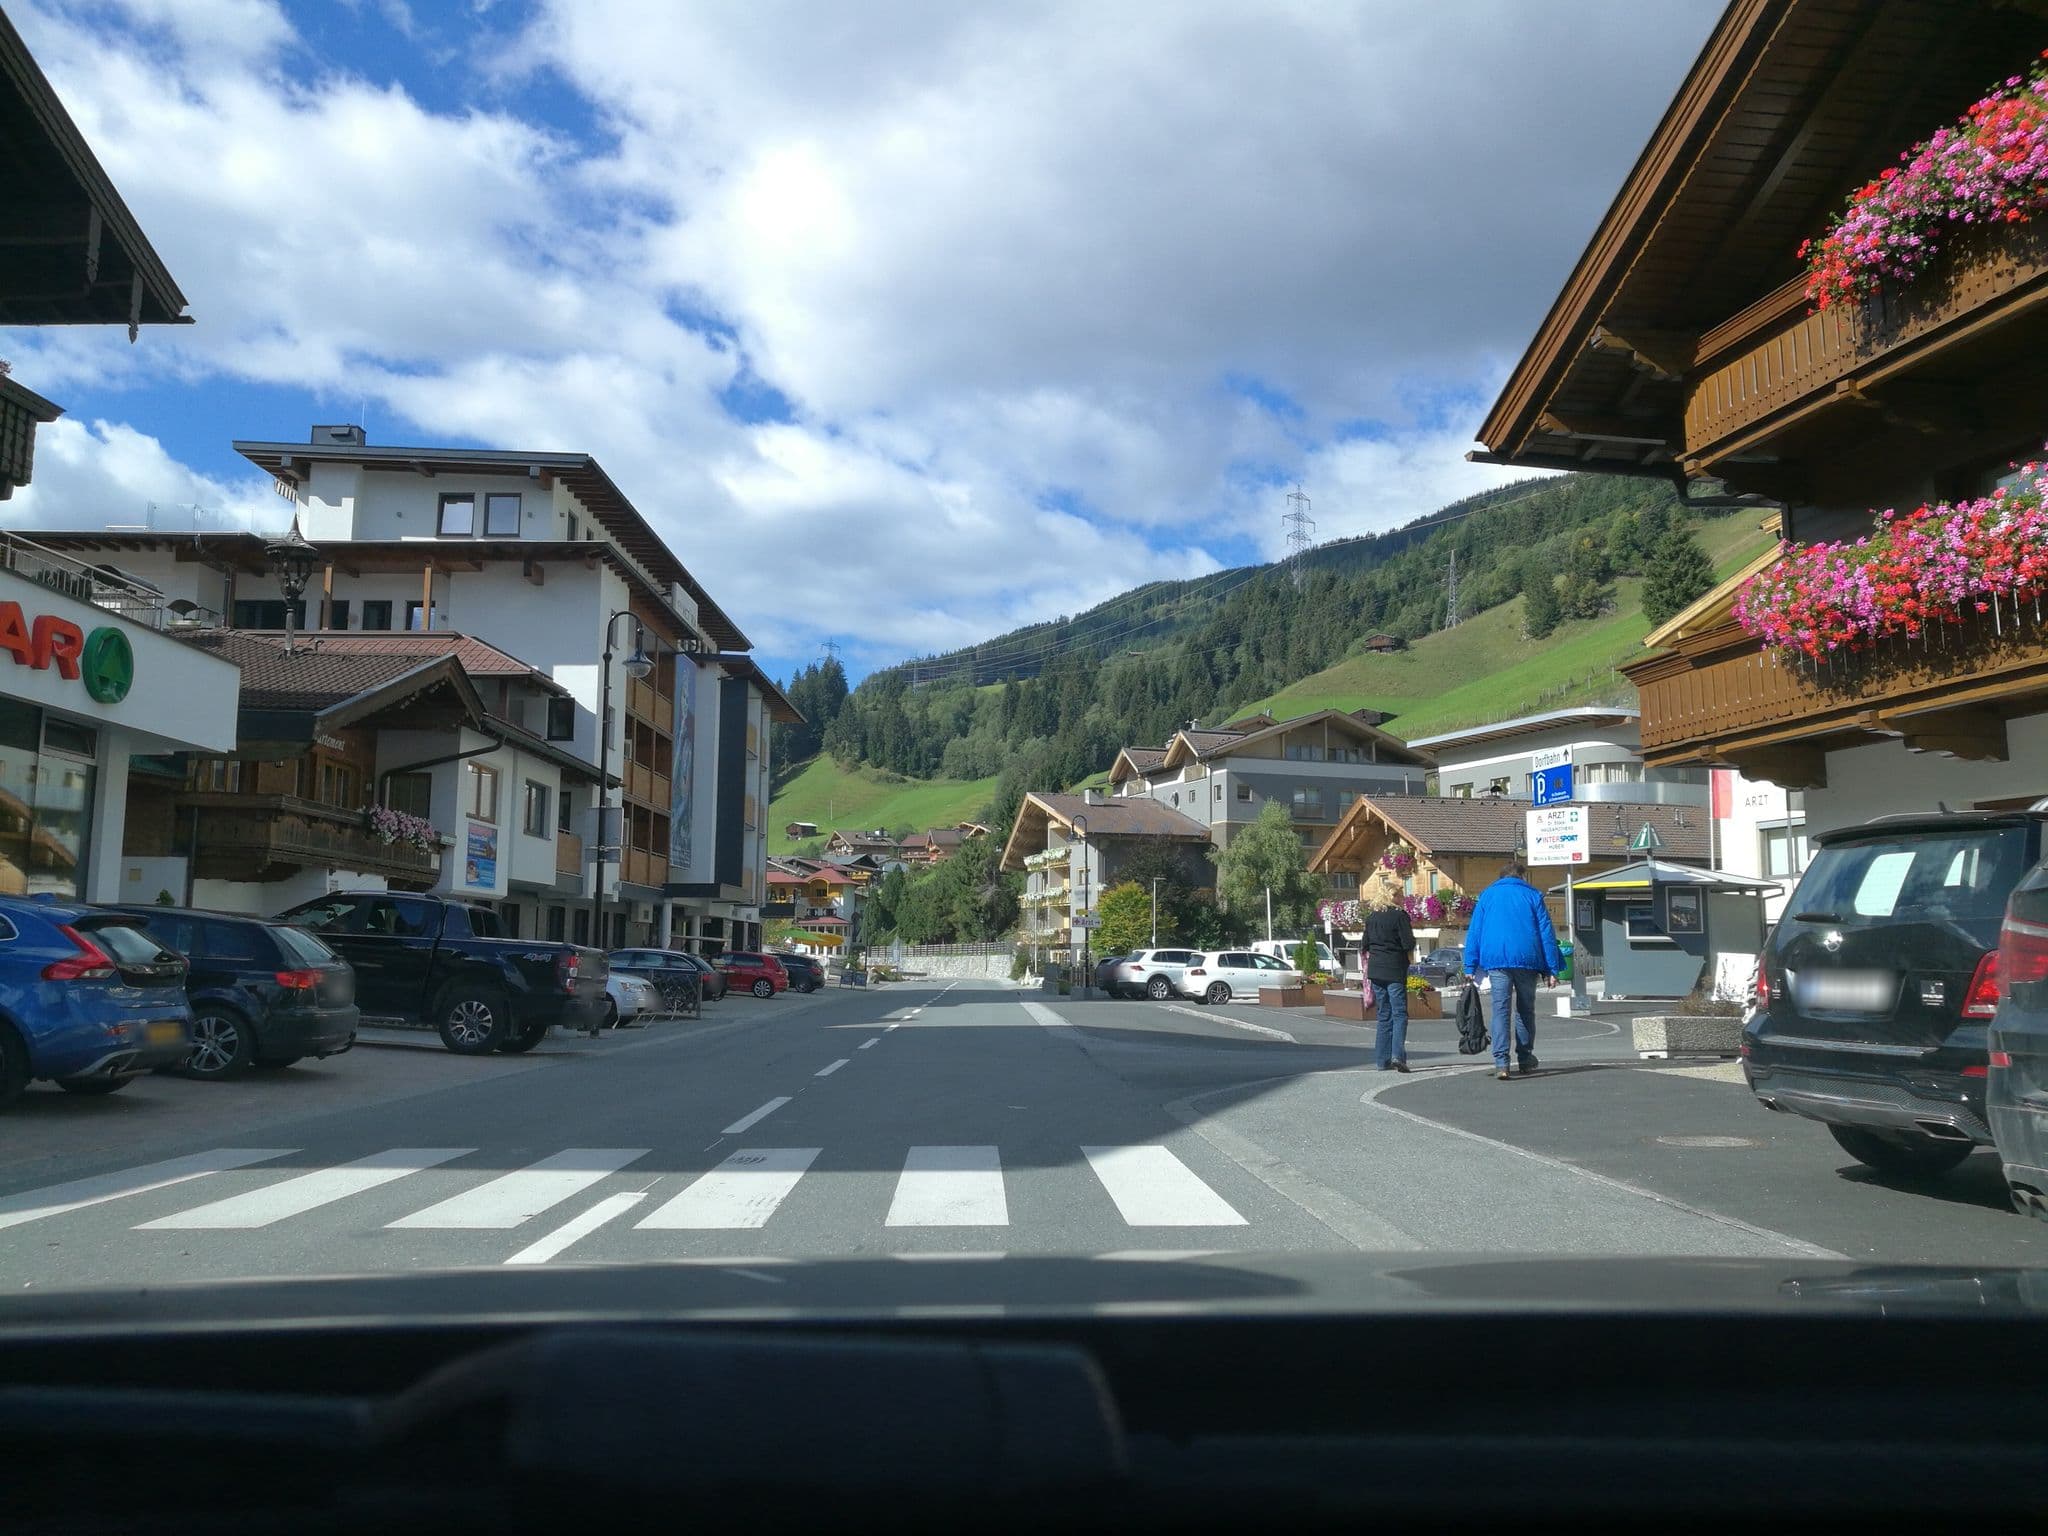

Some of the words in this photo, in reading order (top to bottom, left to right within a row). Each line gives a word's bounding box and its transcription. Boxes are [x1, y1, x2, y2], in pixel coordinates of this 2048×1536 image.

[1535, 753, 1561, 768] Dorfbahn
[1745, 795, 1769, 807] ARZT
[1547, 811, 1566, 820] ARZT
[1543, 834, 1579, 843] INTERSPORT
